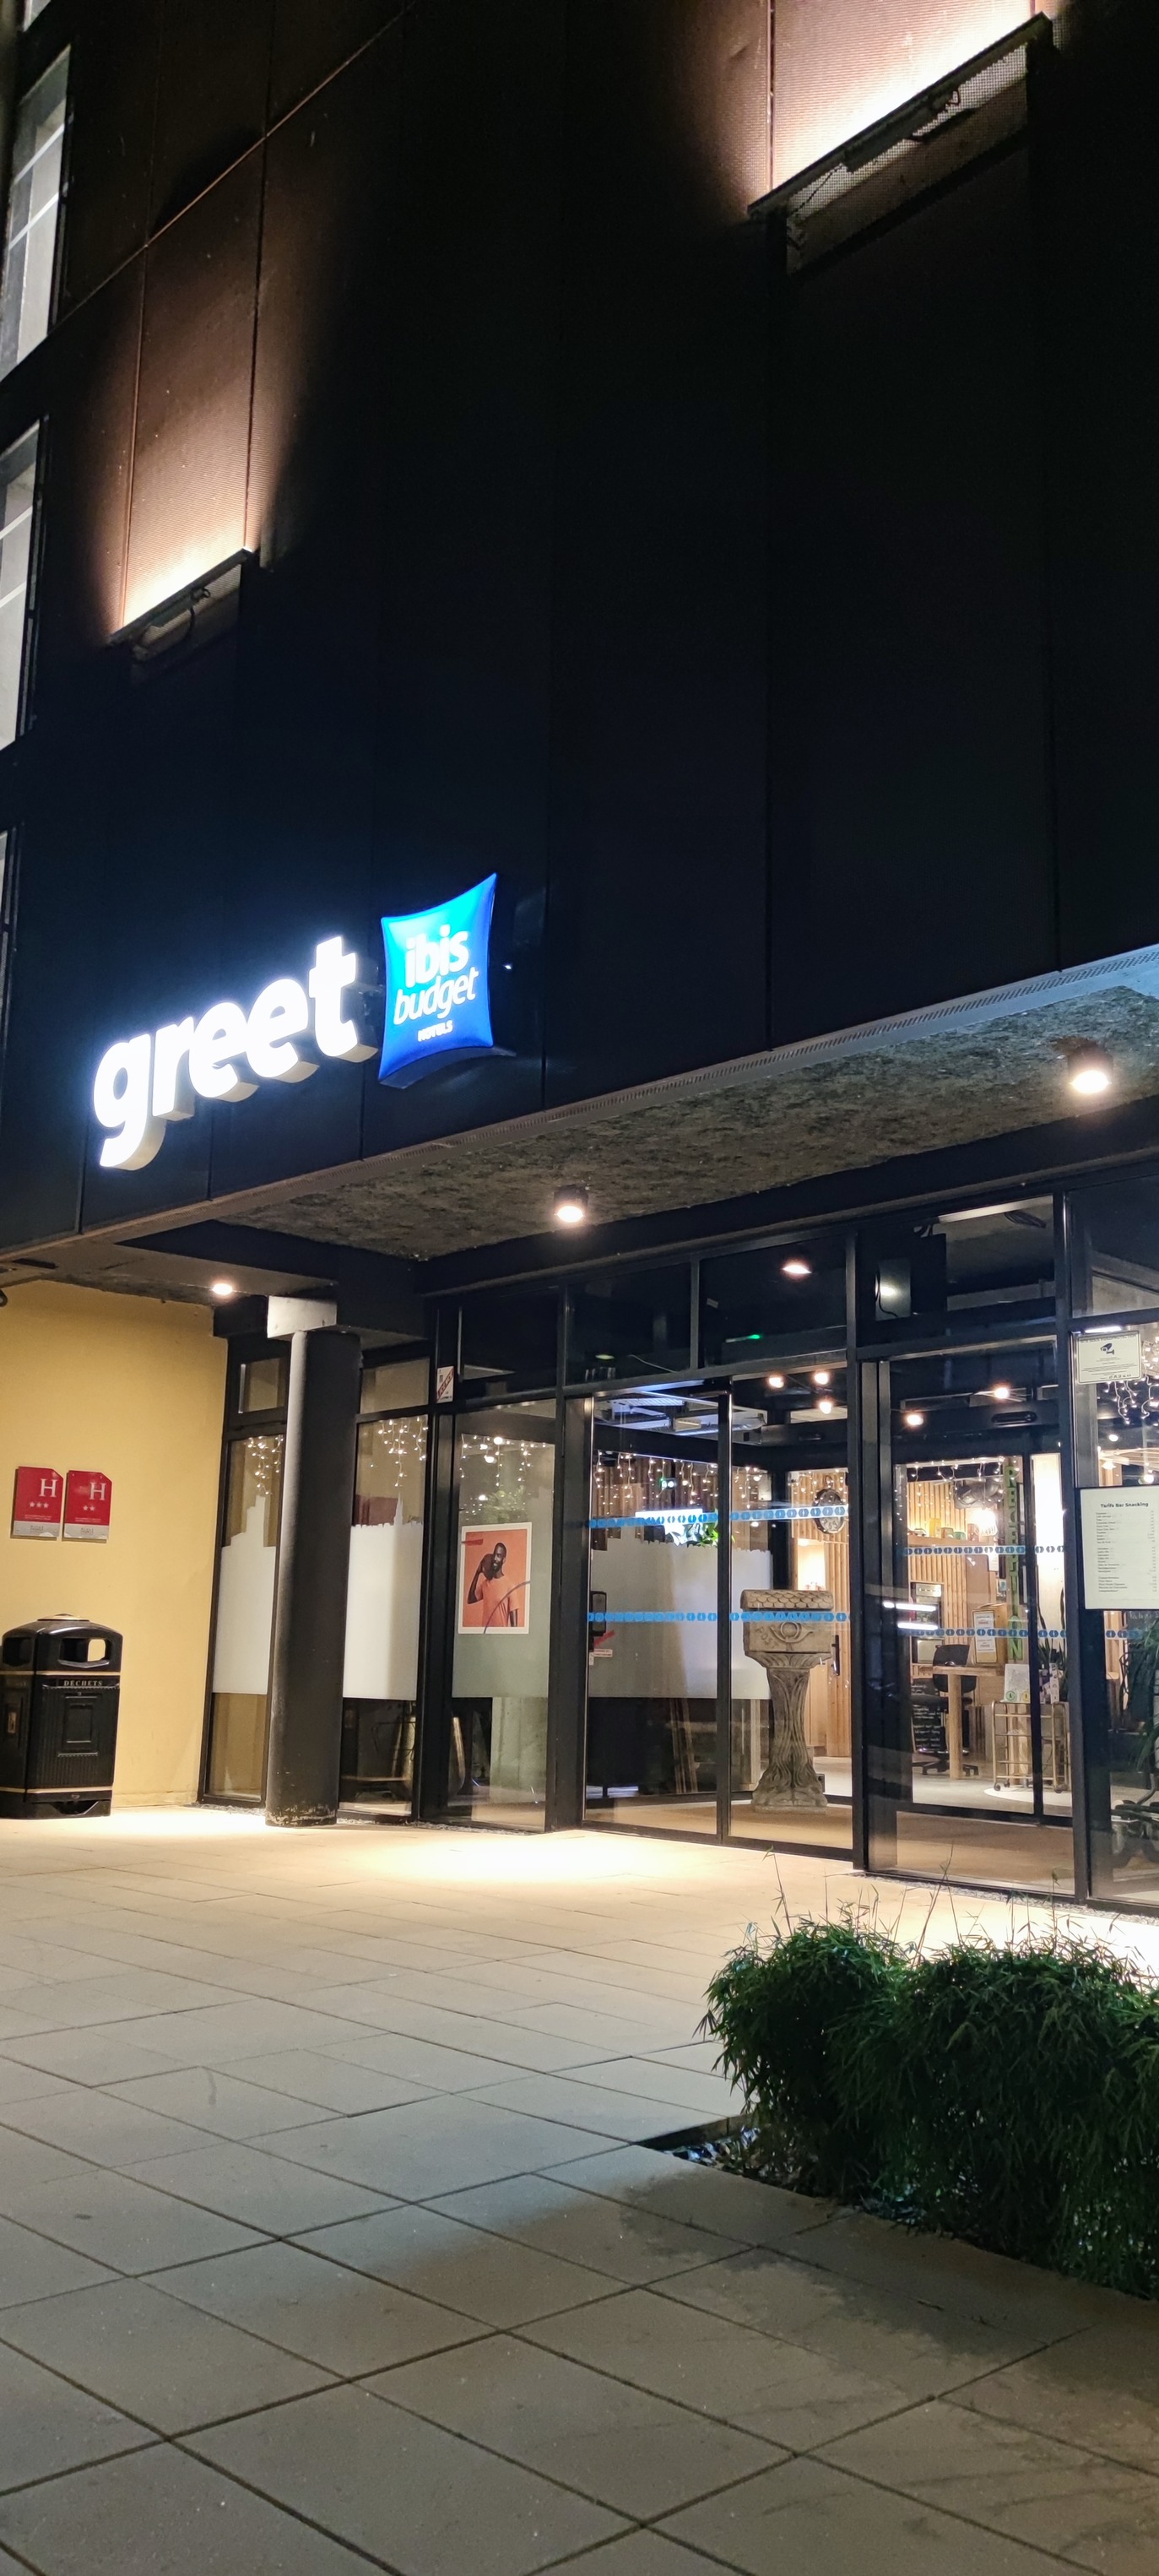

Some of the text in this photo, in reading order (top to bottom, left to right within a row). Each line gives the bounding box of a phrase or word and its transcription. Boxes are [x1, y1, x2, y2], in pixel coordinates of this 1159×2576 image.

[405, 924, 469, 988] ibis
[393, 967, 479, 1025] budget
[93, 935, 358, 1169] greet
[39, 1478, 58, 1498] H
[89, 1482, 106, 1501] H
